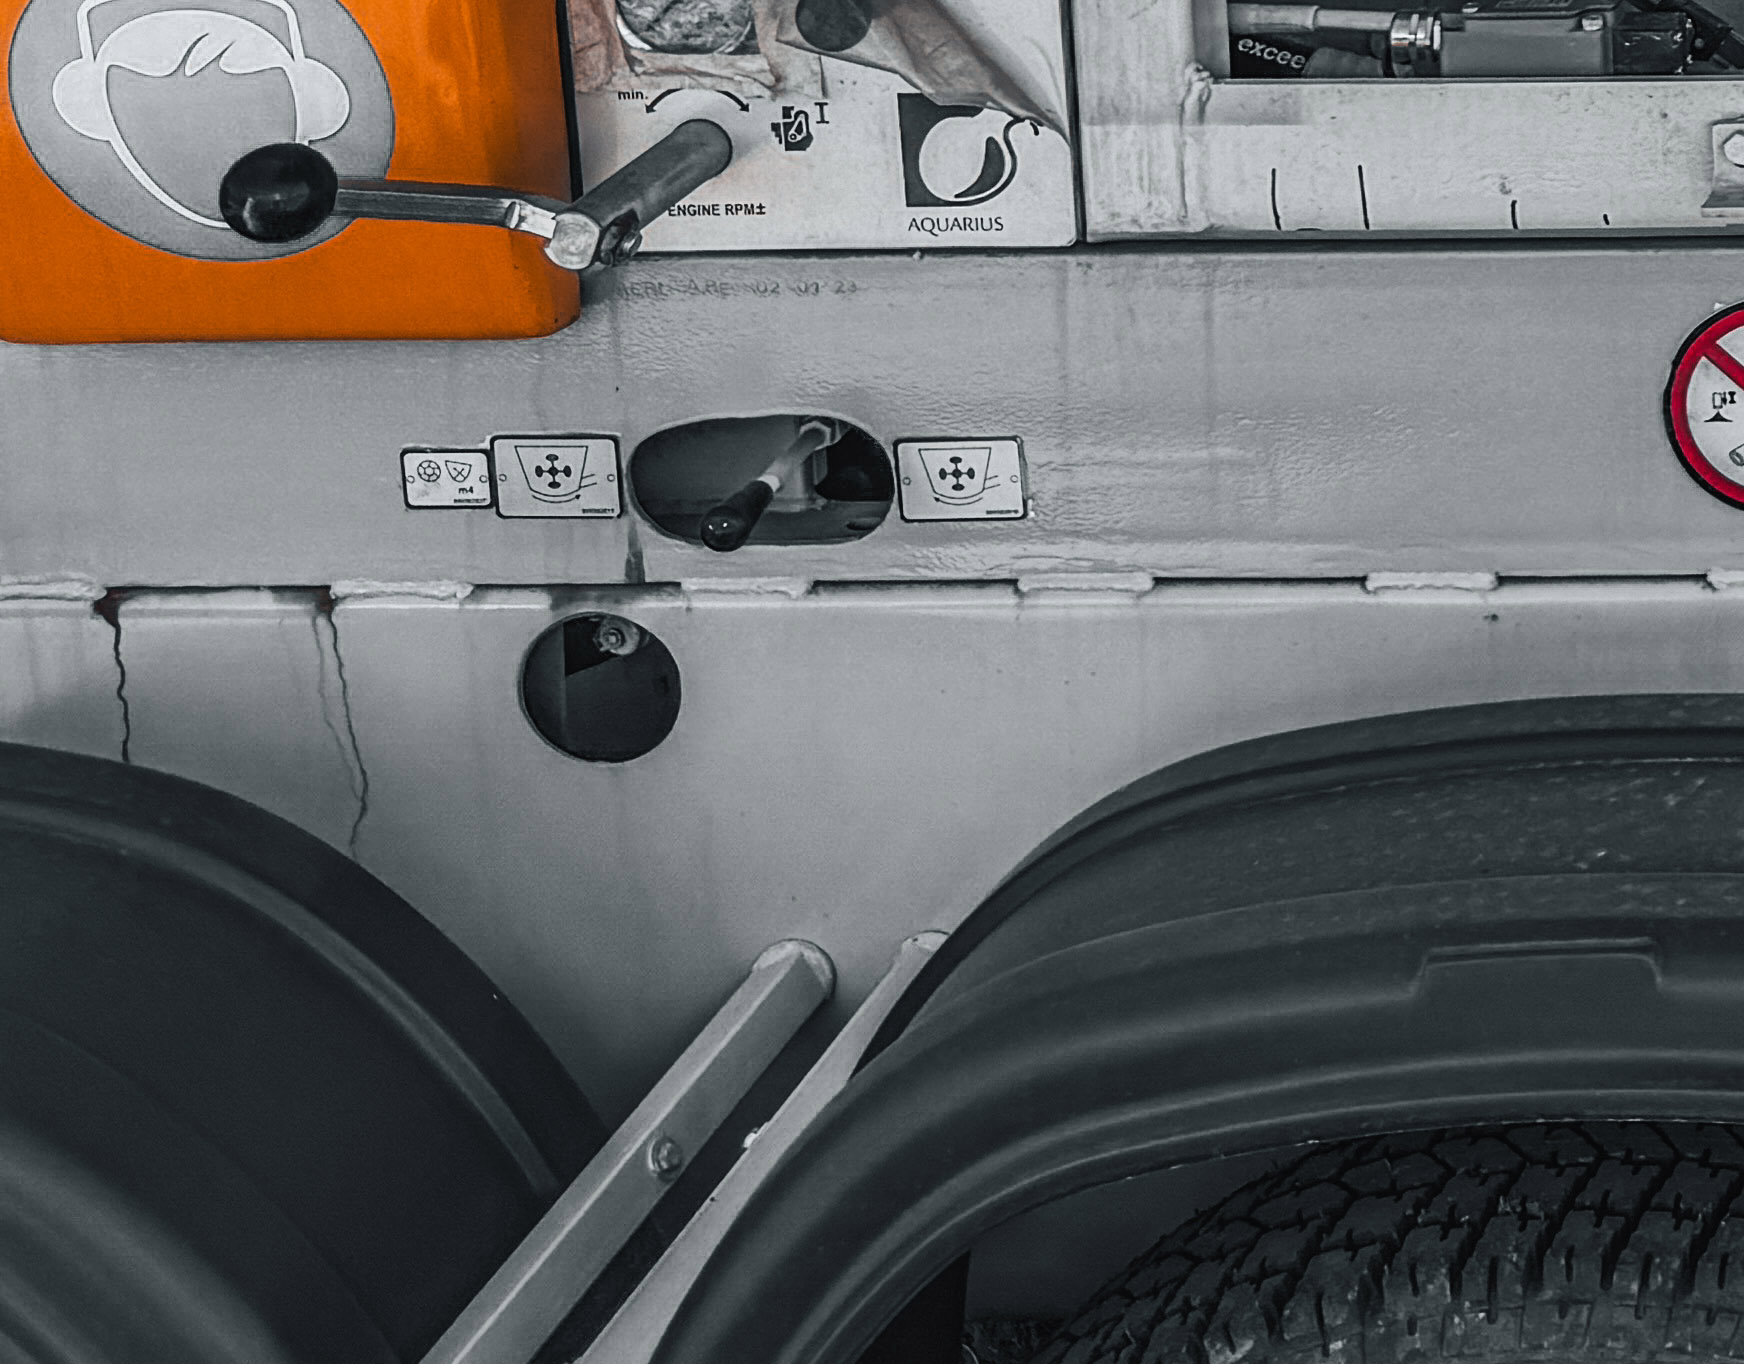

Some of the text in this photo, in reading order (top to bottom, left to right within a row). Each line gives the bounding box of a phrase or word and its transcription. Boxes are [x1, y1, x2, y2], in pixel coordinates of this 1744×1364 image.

[617, 90, 649, 100] min.
[667, 203, 720, 217] ENGINE
[908, 216, 1004, 237] AQUARIUS
